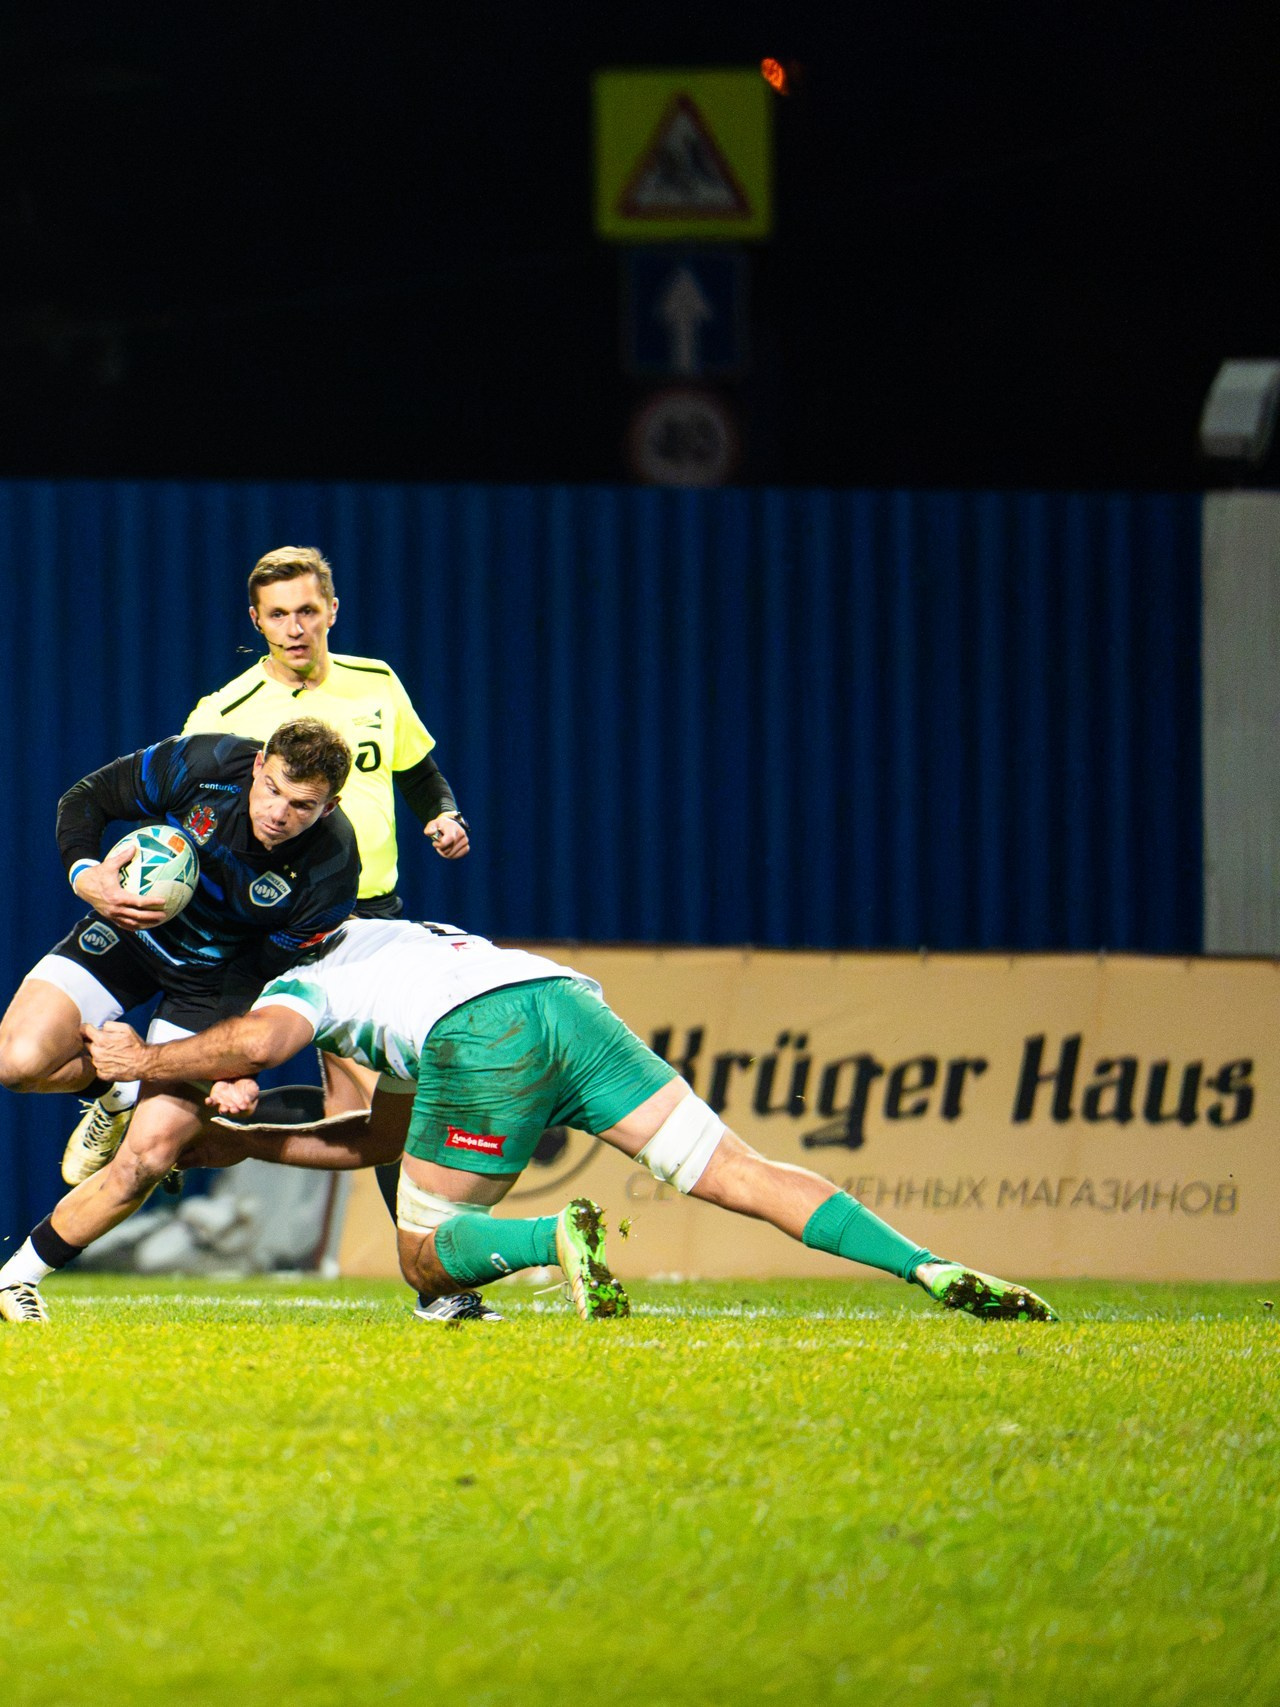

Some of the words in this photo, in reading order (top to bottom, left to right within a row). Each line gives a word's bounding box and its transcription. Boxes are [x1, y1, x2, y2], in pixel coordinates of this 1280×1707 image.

[651, 1024, 989, 1150] Krüger
[1013, 1032, 1254, 1126] Haus
[997, 1177, 1238, 1216] МАГАЗИНОВ
